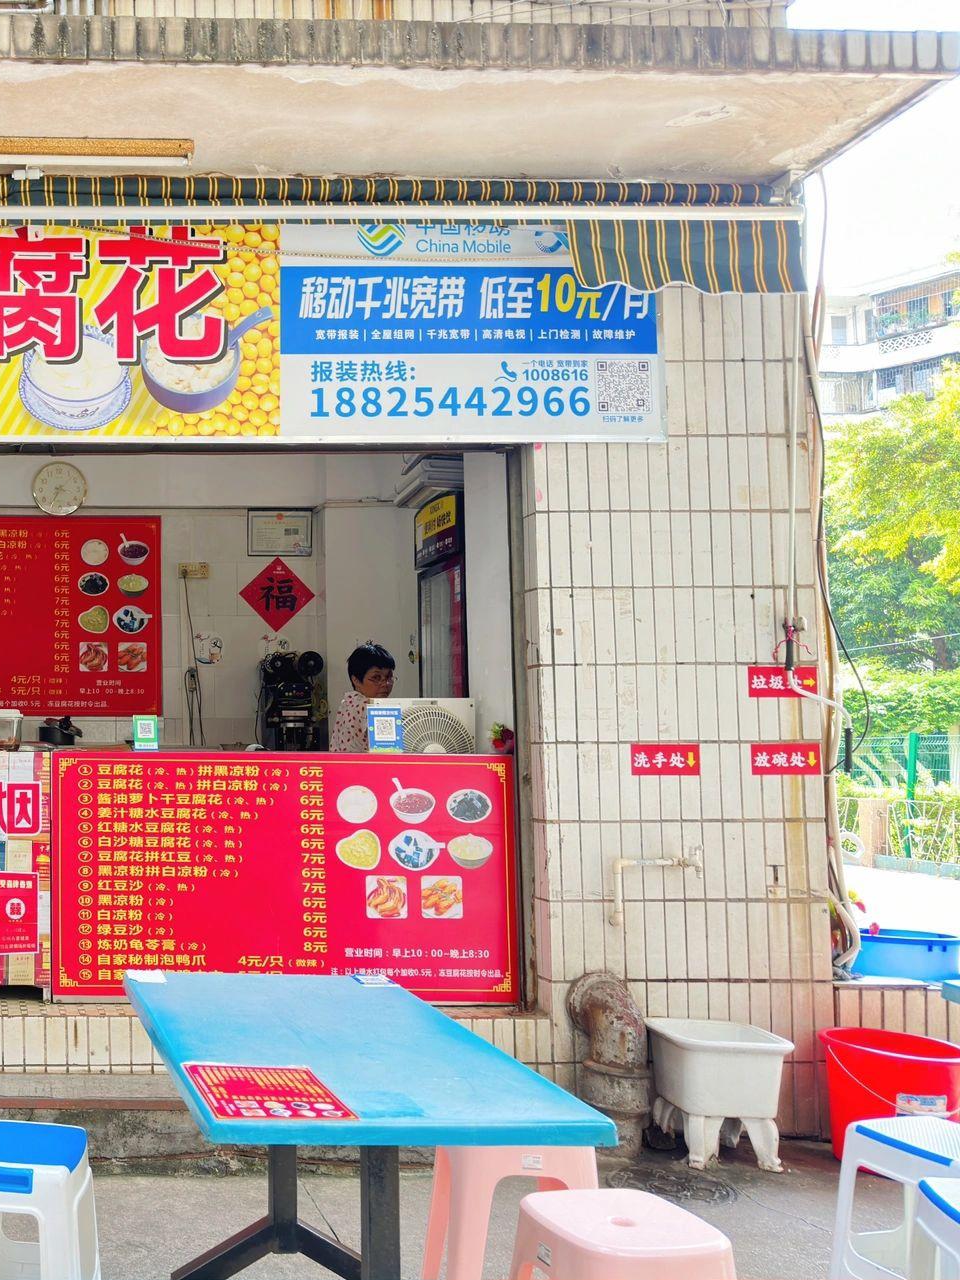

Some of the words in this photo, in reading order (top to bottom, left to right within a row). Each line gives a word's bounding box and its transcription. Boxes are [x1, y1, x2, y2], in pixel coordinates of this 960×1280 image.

[416, 239, 458, 253] China
[463, 239, 511, 254] Mobile
[299, 277, 466, 319] 移动千兆宽带
[315, 329, 359, 340] 宽带报装
[371, 329, 415, 340] 全屋组网
[427, 329, 470, 340] 千兆宽带
[482, 329, 525, 340] 高清电视
[537, 329, 581, 340] 上门检测
[592, 329, 636, 340] 故障维护
[522, 360, 553, 368] 一个电话
[522, 369, 588, 381] 1008616
[310, 386, 590, 417] 18825442966
[602, 415, 644, 423] 扫码了解更多
[259, 577, 298, 611] 福
[633, 752, 685, 768] 洗手处
[754, 752, 806, 768] 放碗处
[299, 766, 323, 777] 6元
[300, 780, 323, 791] 6元
[300, 795, 323, 806] 6元
[300, 810, 324, 821] 6元
[301, 824, 324, 835] 6元
[301, 838, 325, 850] 6元
[302, 853, 325, 864] 7元
[302, 867, 326, 878] 6元
[302, 882, 326, 894] 7元
[303, 897, 326, 909] 6元
[303, 912, 326, 923] 6元
[303, 926, 327, 938] 6元
[304, 941, 327, 953] 8元
[97, 954, 206, 966] 自家秘制泡鸭爪
